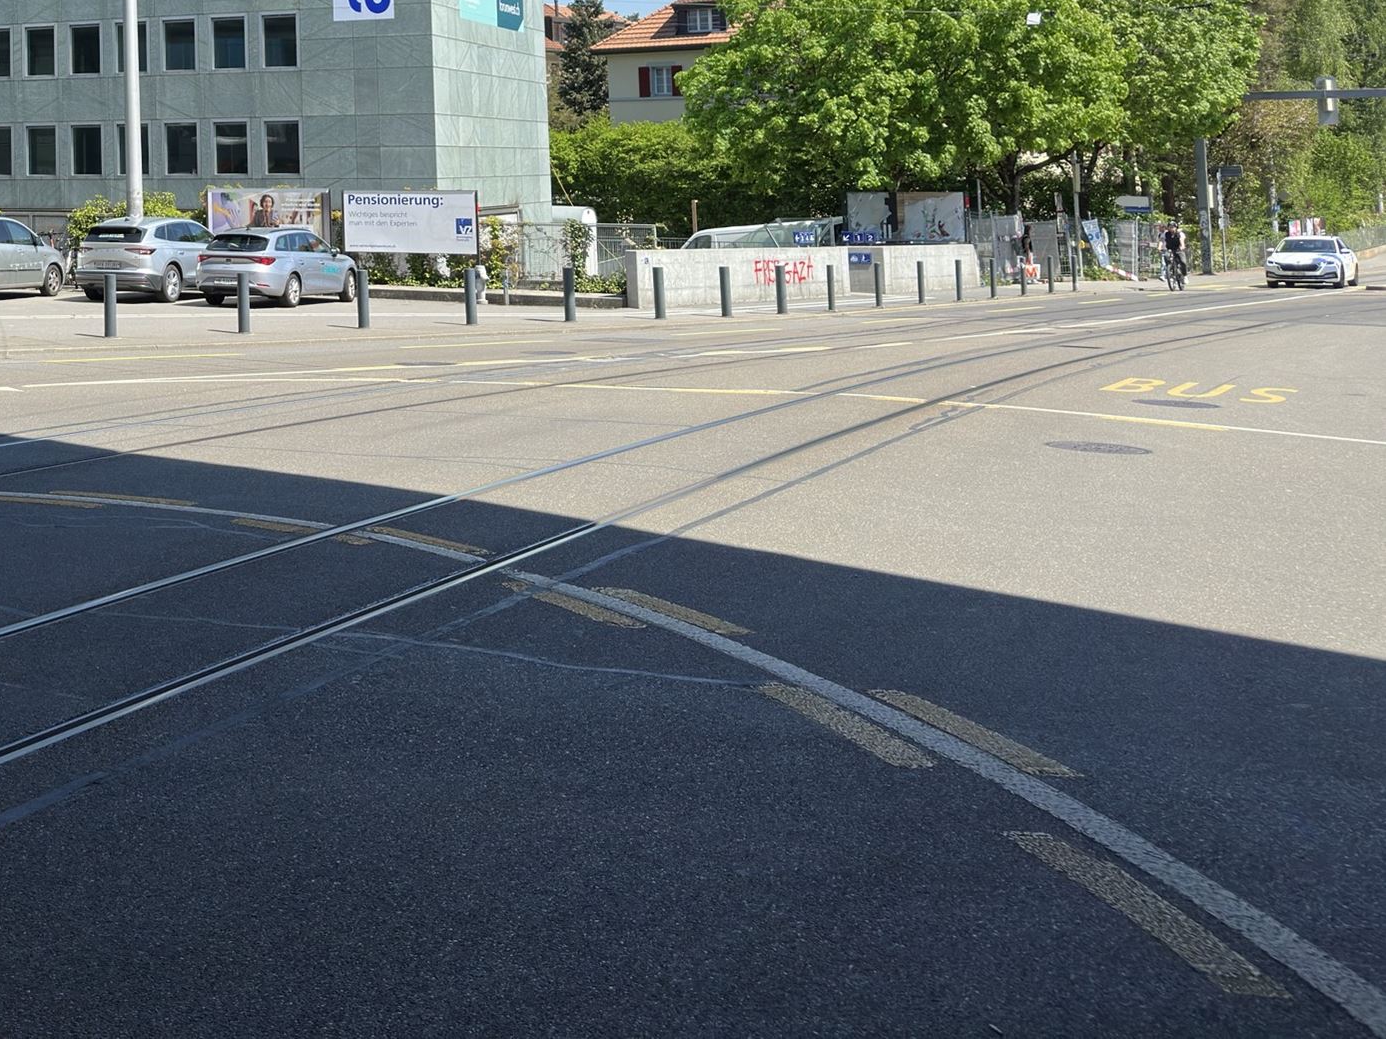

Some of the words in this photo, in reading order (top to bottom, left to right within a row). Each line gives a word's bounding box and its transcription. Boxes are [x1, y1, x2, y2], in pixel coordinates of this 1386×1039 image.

[348, 194, 444, 209] Pensionierung:
[349, 211, 378, 219] Wichtiges
[1099, 377, 1299, 404] BUS
